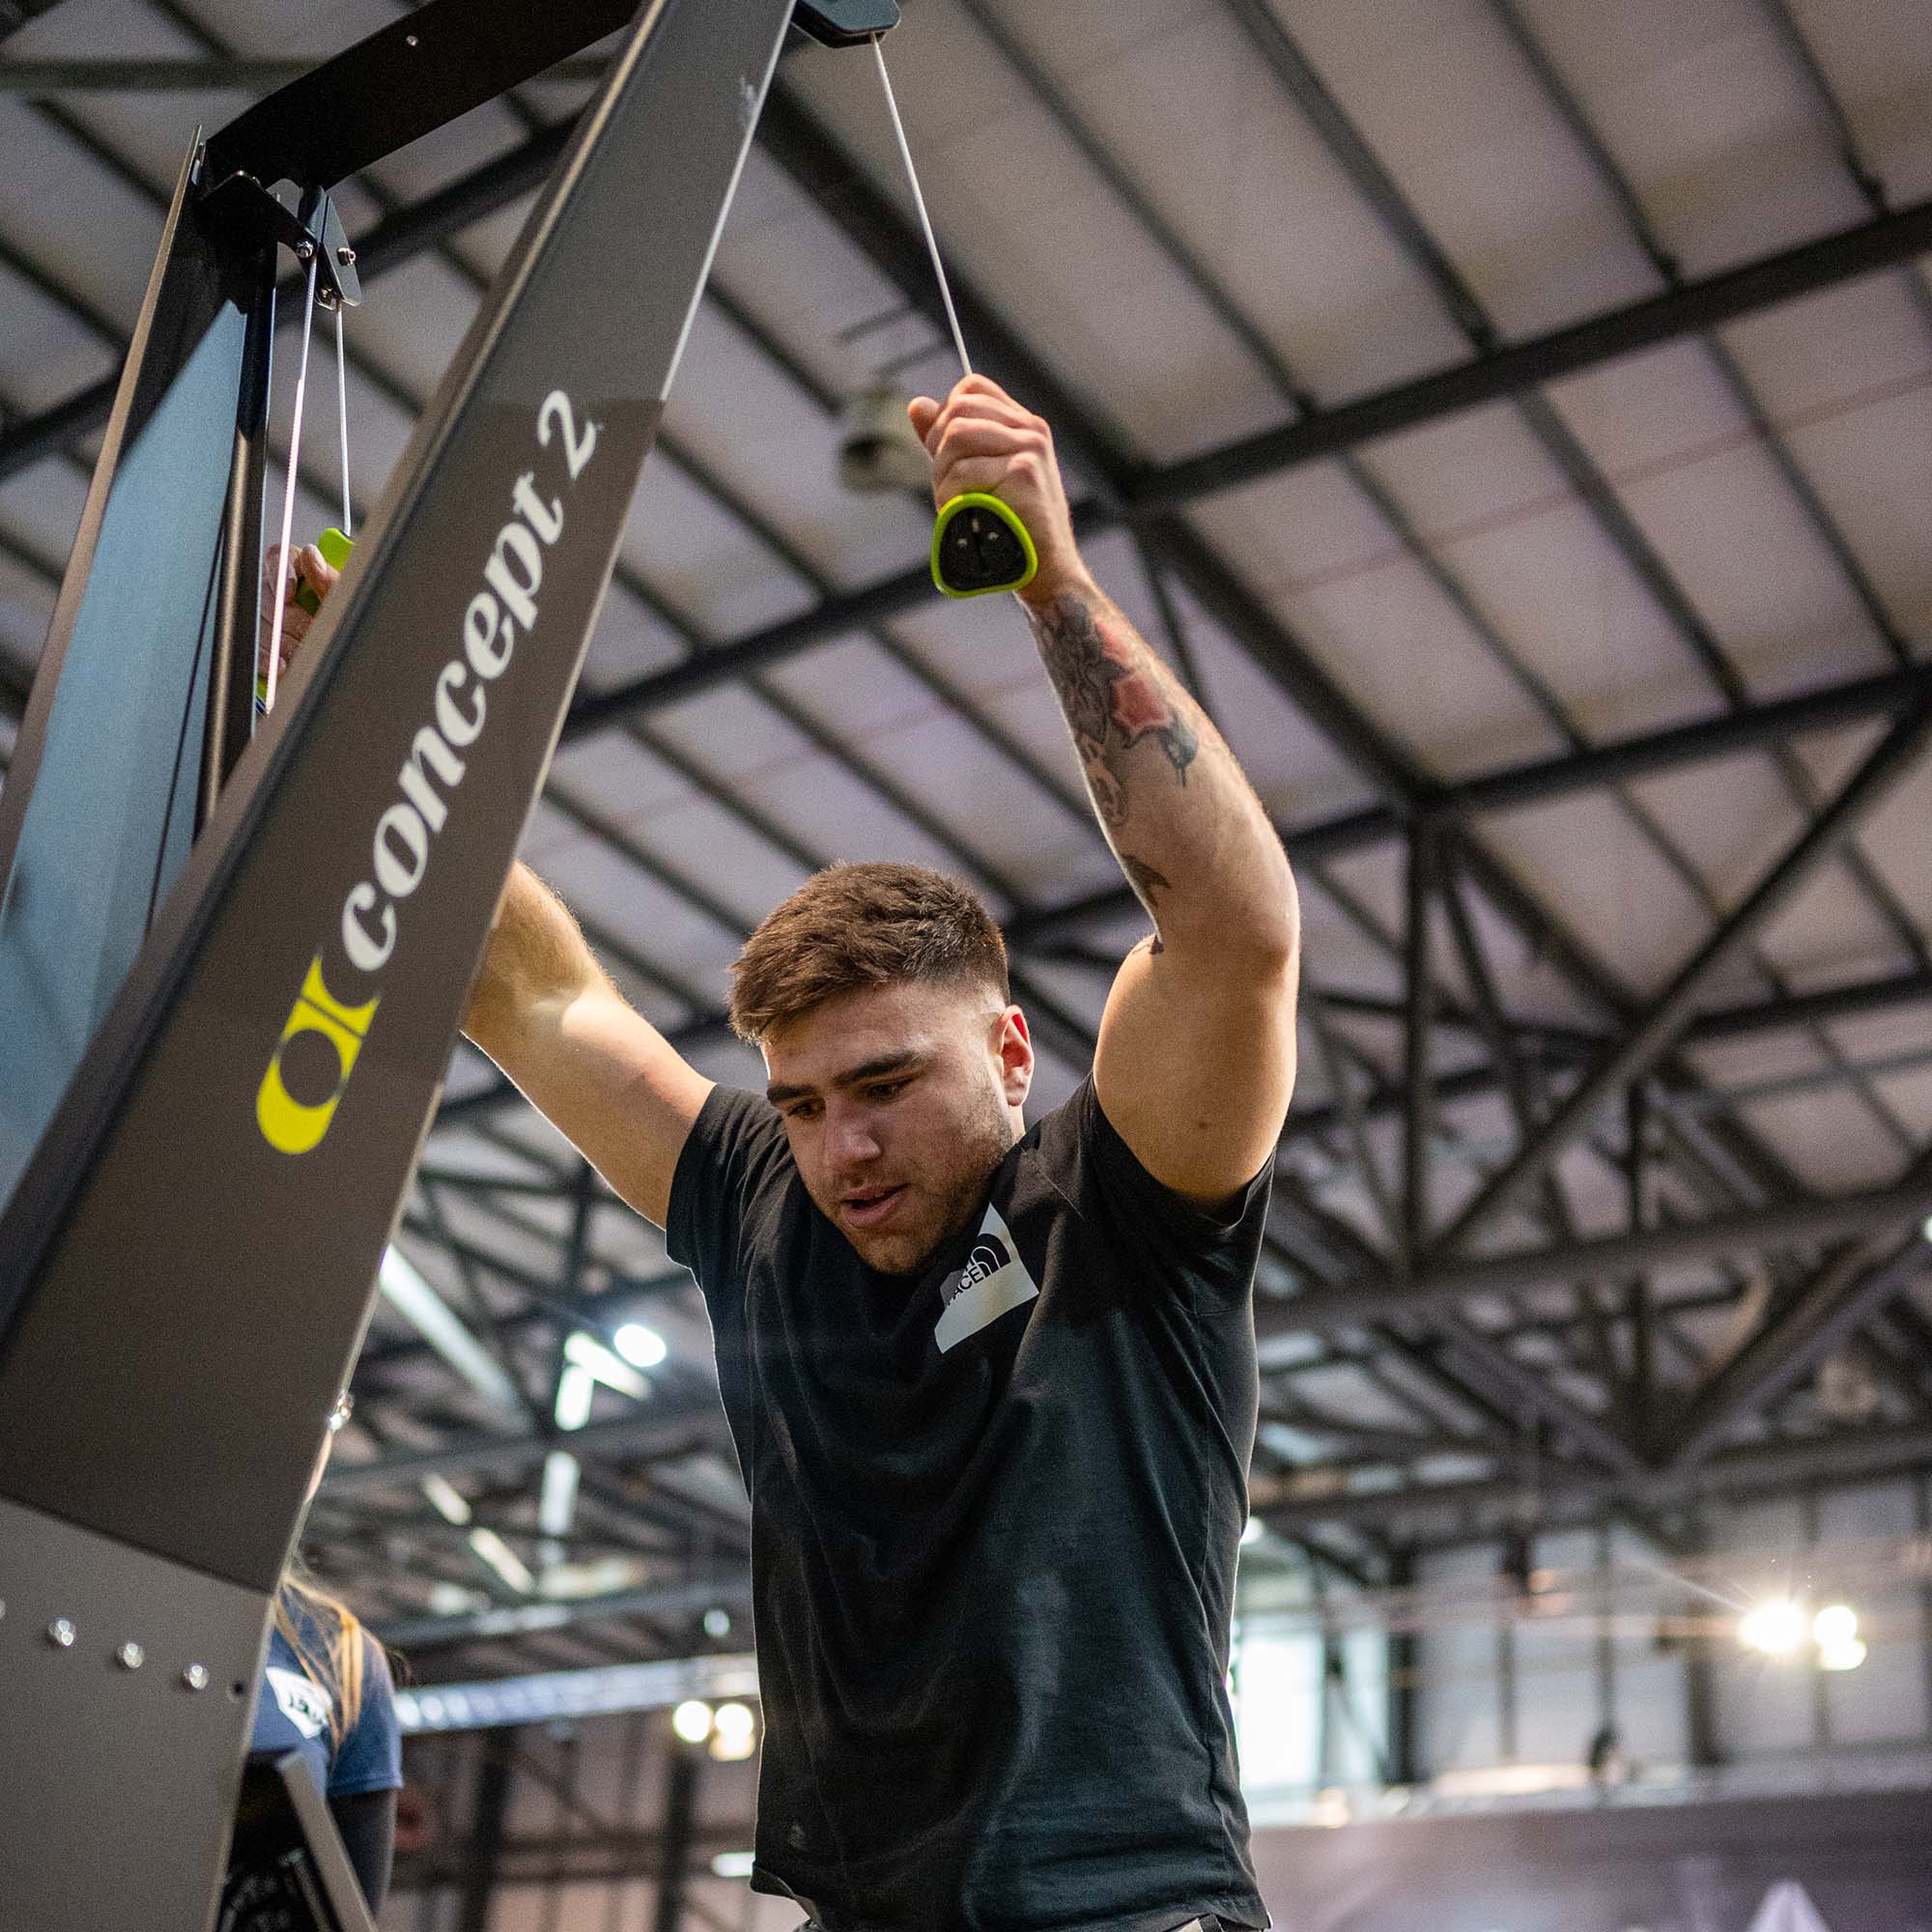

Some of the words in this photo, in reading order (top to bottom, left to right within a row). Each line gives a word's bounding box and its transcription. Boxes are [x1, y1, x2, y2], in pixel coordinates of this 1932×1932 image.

[342, 471, 564, 972] concept
[537, 389, 597, 480] 2
[948, 1265, 984, 1306] ACE
